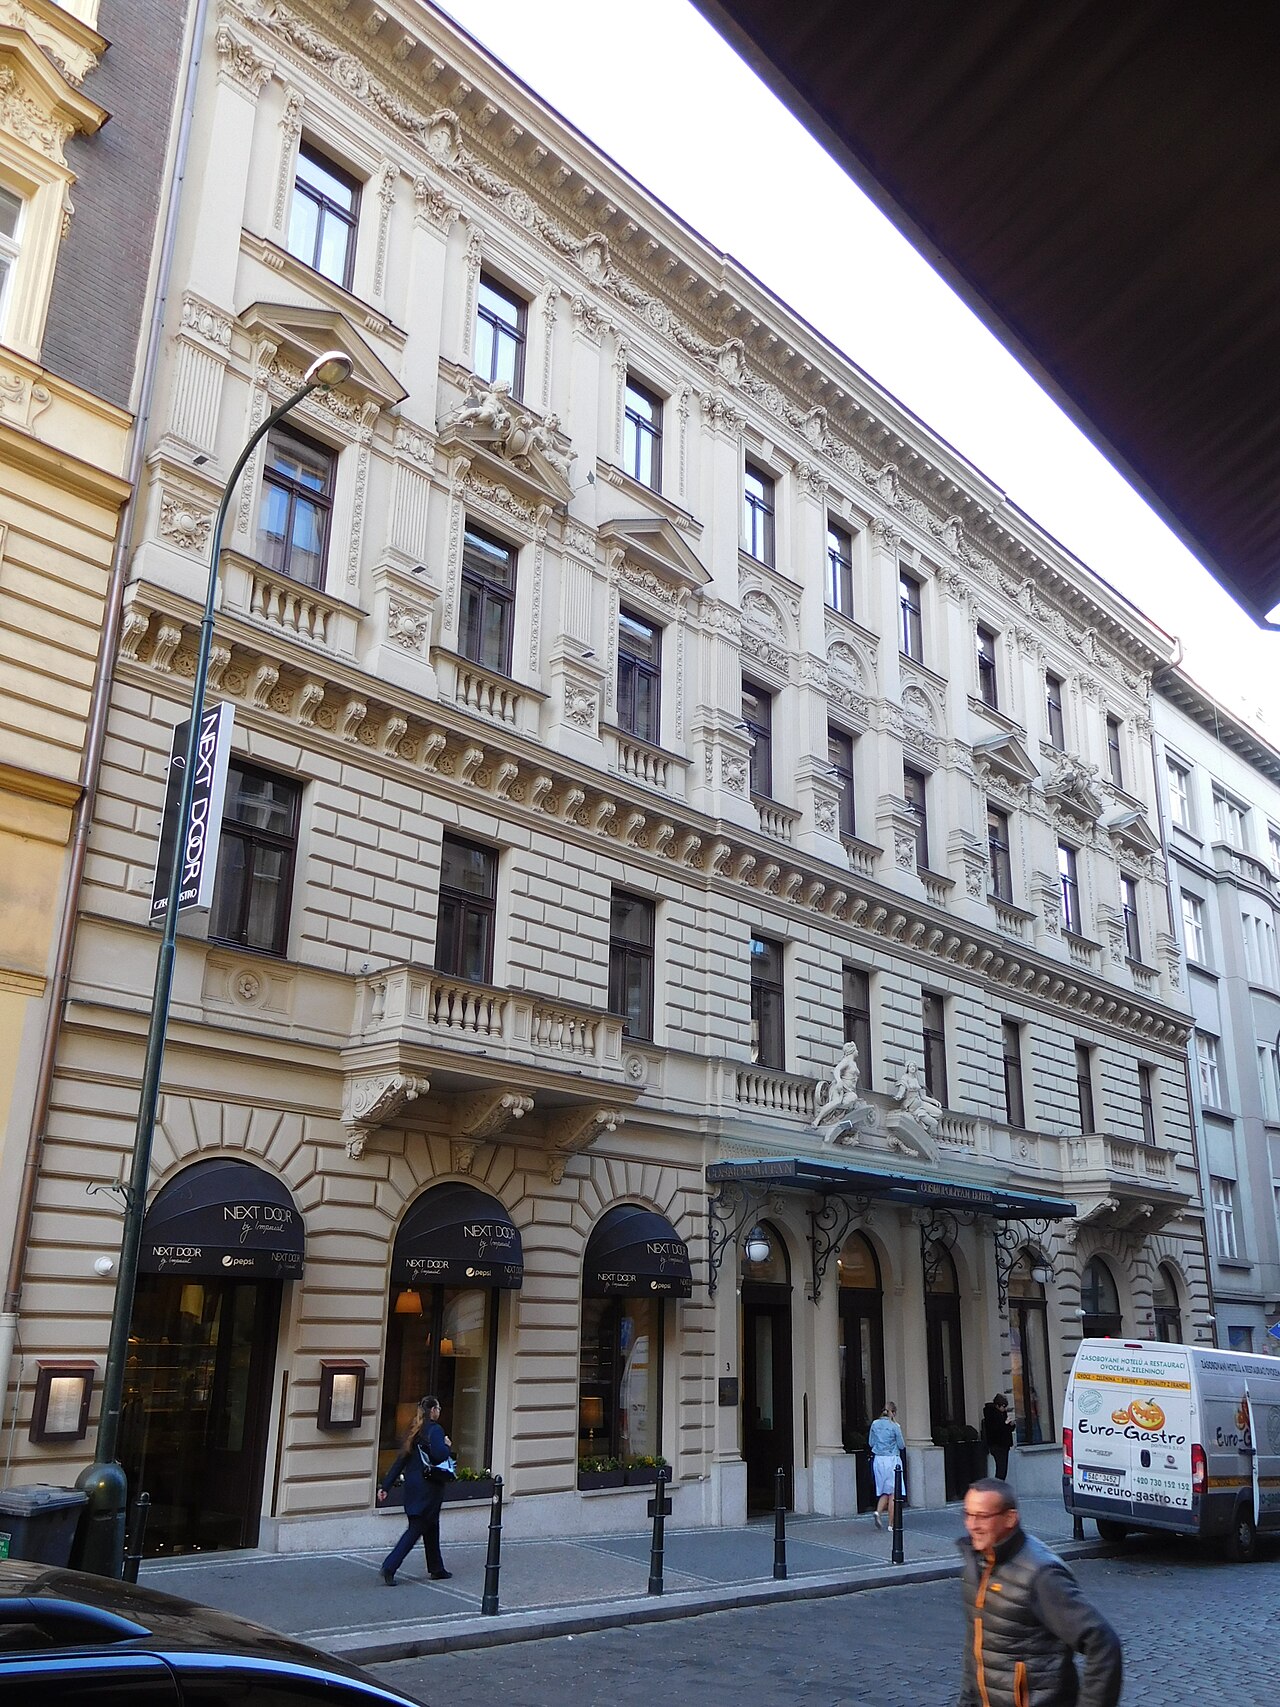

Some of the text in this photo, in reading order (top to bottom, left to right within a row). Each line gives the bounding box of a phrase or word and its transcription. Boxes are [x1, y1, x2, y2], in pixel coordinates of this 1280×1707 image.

[183, 712, 218, 885] NEXT DOOR
[707, 1163, 792, 1178] COSMOPOLITAN
[921, 1182, 970, 1199] COSMOPOLITAN
[224, 1206, 293, 1223] NEXT DOOR
[239, 1222, 251, 1243] by
[464, 1225, 516, 1239] NEXT DOOR
[152, 1246, 202, 1257] NEXT DOOR
[647, 1243, 670, 1254] NEXT
[233, 1257, 255, 1266] pepsi
[271, 1252, 288, 1261] NEXT
[406, 1260, 449, 1269] NEXT DOOR
[617, 1274, 637, 1282] DOOR
[726, 1362, 731, 1372] 3
[1100, 1364, 1124, 1372] OVOCEM
[1132, 1367, 1165, 1375] ZELENINOU
[1078, 1419, 1185, 1444] Euro-Gastro
[1216, 1427, 1252, 1447] Euro-G
[1164, 1481, 1175, 1489] 152
[1078, 1482, 1188, 1506] www.euro-gastro.cz
